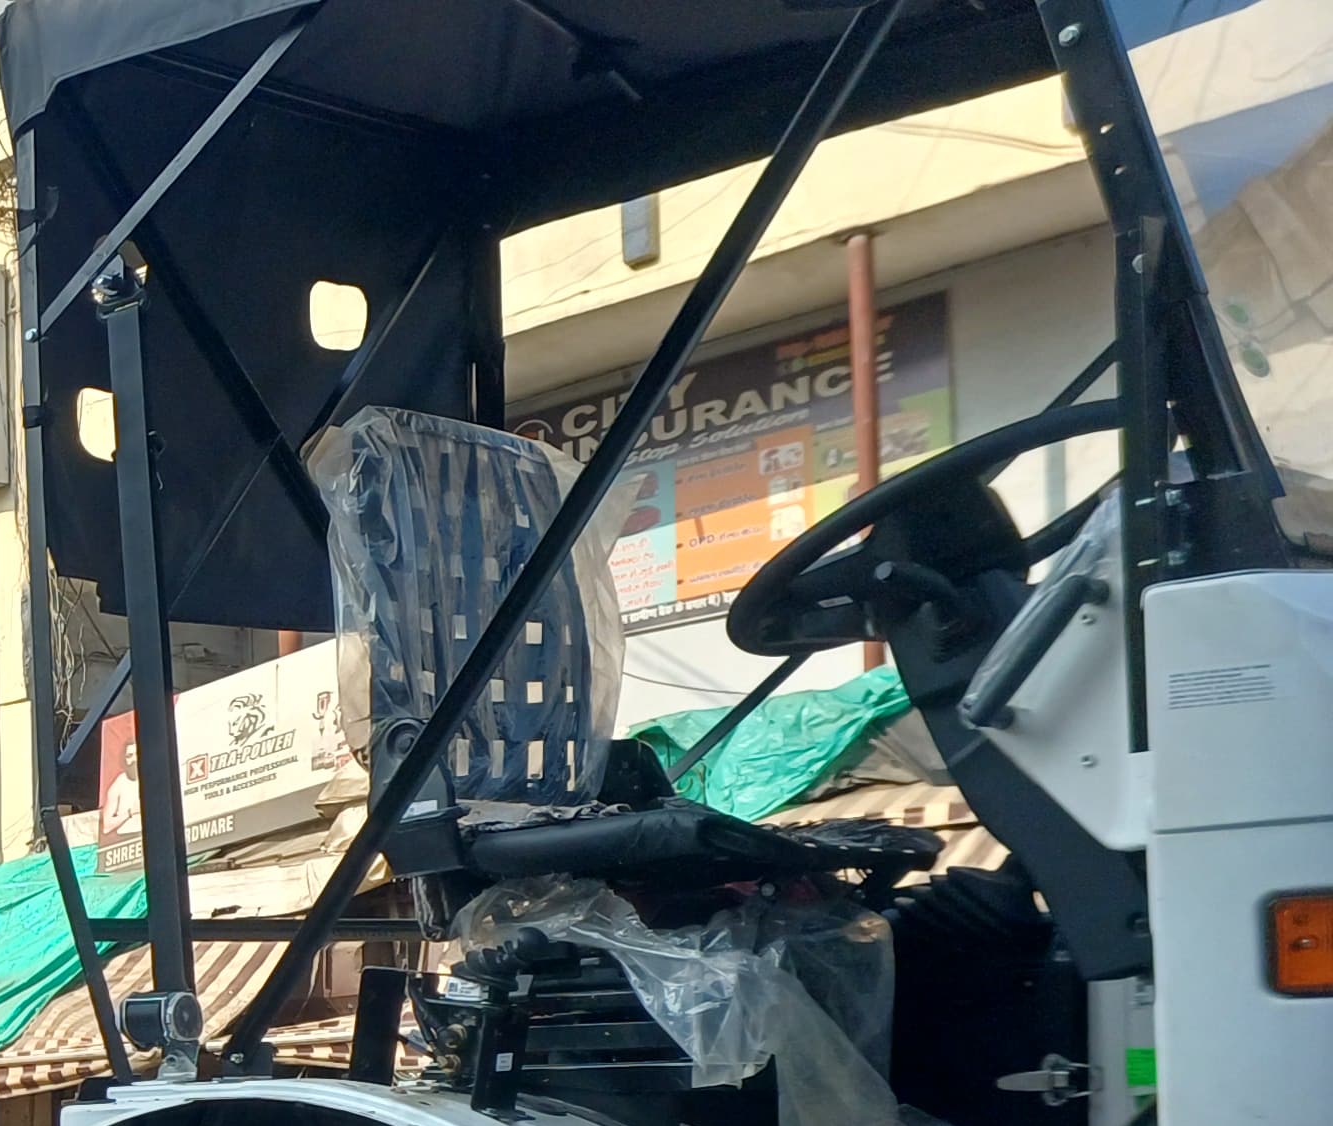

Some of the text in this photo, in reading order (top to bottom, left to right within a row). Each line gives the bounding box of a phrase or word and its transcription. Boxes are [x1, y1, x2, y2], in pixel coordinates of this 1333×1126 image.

[561, 371, 698, 440] CIY
[200, 771, 248, 791] PERFORMANCE
[249, 755, 299, 777] PROFESSIONAL
[225, 786, 231, 795] &
[232, 772, 278, 793] ACCESSORIES
[105, 815, 234, 867] SHREE RDWARE
